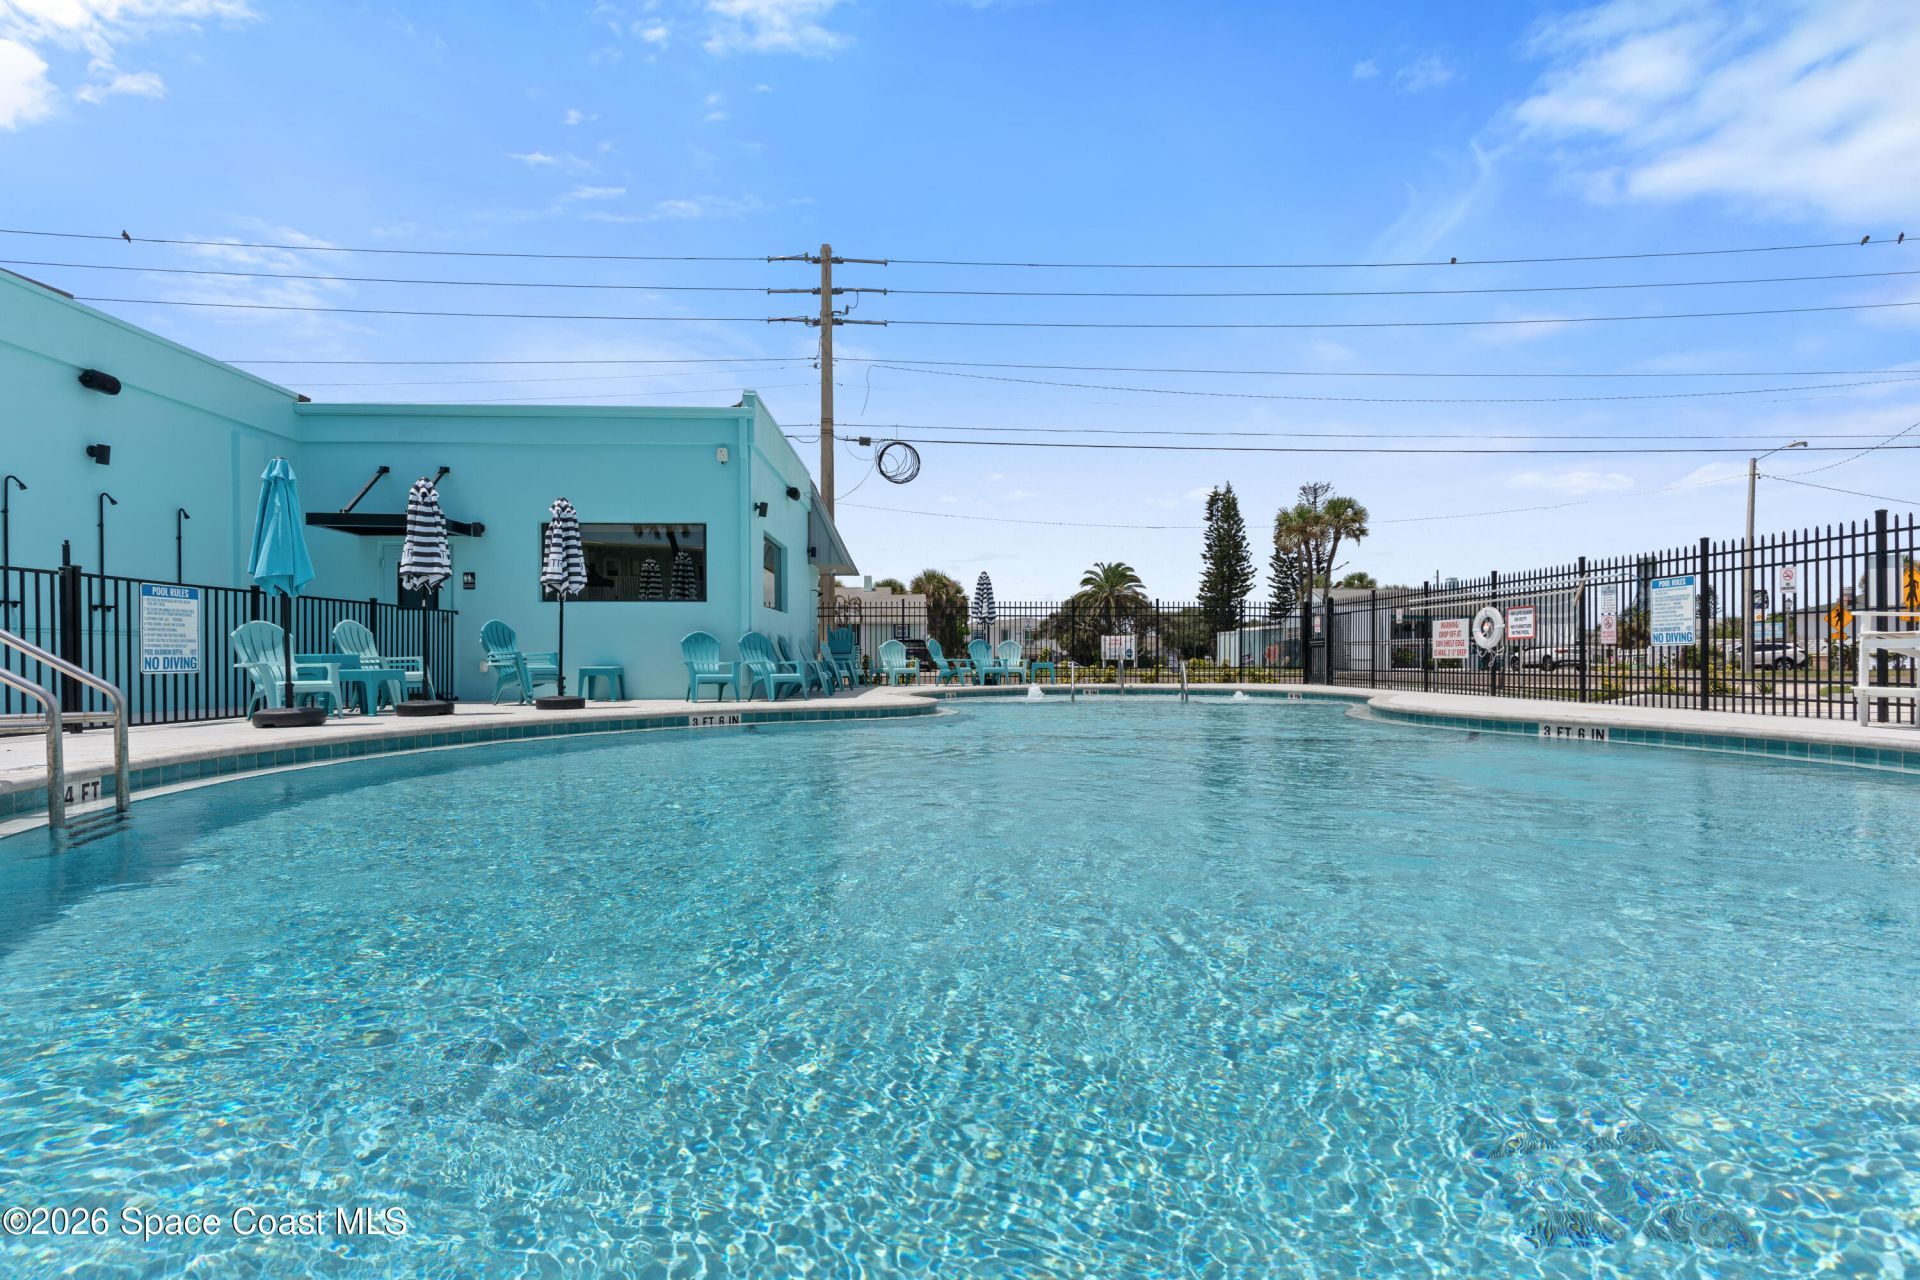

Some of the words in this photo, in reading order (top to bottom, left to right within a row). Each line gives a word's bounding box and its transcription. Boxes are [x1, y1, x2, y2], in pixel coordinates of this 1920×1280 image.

[1658, 580, 1670, 588] POOL
[1672, 578, 1686, 586] RULES
[152, 586, 168, 596] POOL
[170, 588, 189, 598] RULES
[1653, 632, 1663, 642] NO
[1666, 632, 1692, 642] DIVING
[144, 656, 160, 670] NO
[163, 656, 197, 670] DIVING
[692, 717, 699, 726] 3
[703, 716, 714, 725] FT
[719, 716, 724, 724] 6
[729, 716, 739, 724] IN
[1544, 725, 1551, 736] 3
[1557, 727, 1571, 736] FT
[1578, 728, 1585, 738] 6
[1592, 728, 1604, 740] IN
[64, 786, 74, 802] 4
[82, 781, 100, 803] FT
